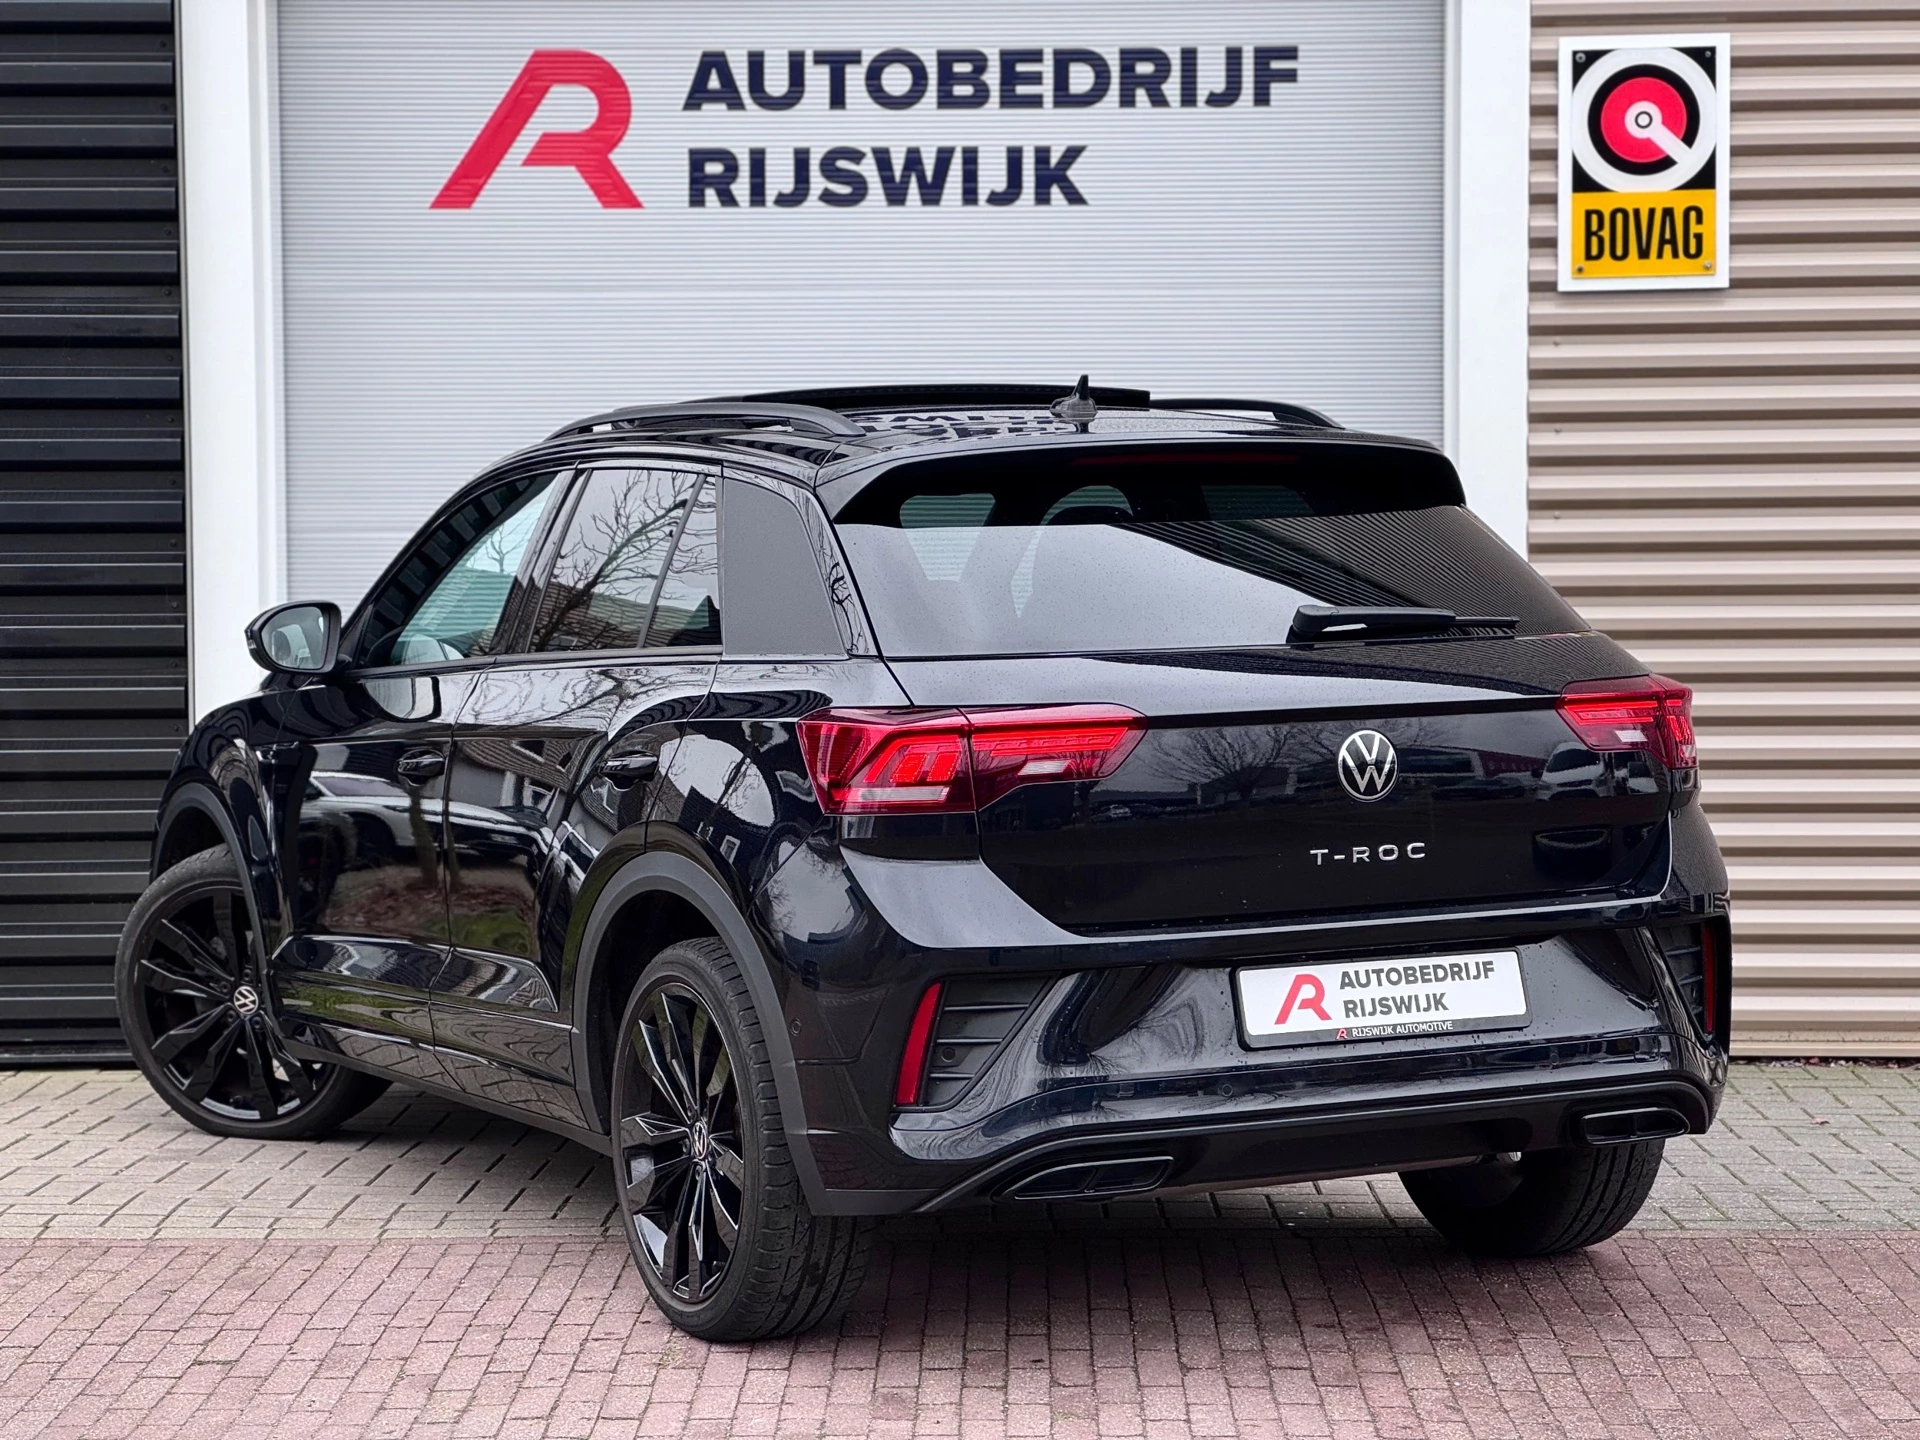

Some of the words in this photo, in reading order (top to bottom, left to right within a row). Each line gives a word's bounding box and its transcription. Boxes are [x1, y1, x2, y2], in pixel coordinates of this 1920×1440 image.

[682, 45, 1299, 112] AUTOBEDRIJF
[687, 145, 1089, 208] RIJSWIJK
[1584, 205, 1704, 262] BOVAG
[1310, 842, 1425, 865] T-ROC
[1340, 961, 1495, 989] AUTOBEDRIJF
[1343, 992, 1449, 1018] RIJSWIJK
[1351, 1025, 1395, 1038] RIJSWIJK
[1396, 1020, 1454, 1034] AUTOMOTIVE
